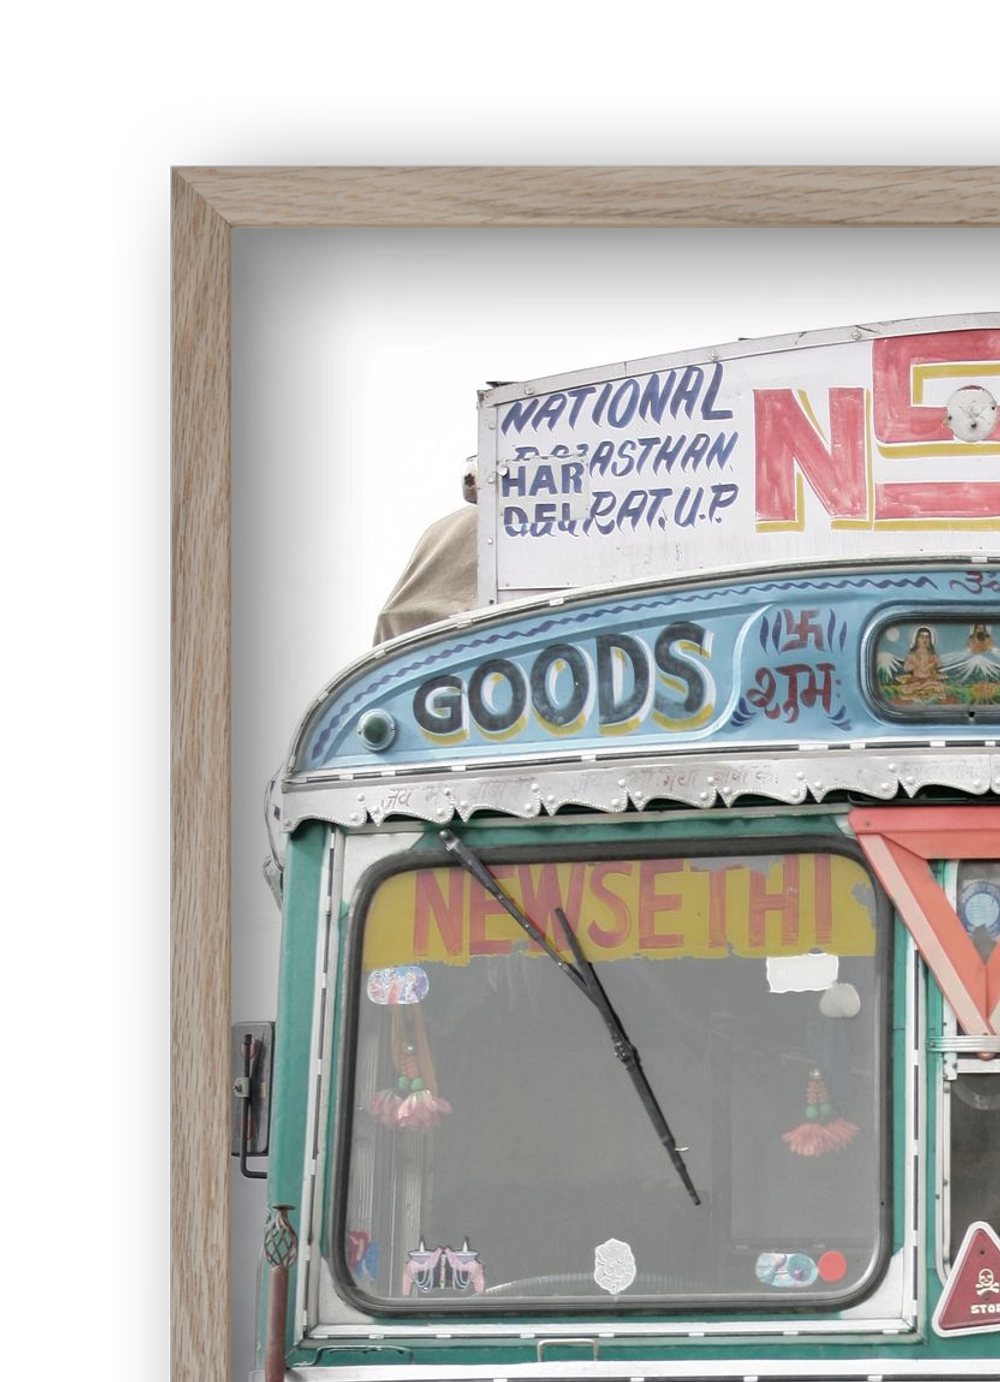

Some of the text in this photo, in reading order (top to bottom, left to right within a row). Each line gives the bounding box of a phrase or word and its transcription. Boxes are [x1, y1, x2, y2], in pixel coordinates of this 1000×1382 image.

[501, 362, 735, 436] NATIONAL
[501, 461, 585, 498] HAR
[513, 430, 739, 478] ASTHAN
[412, 620, 714, 746] GOODS
